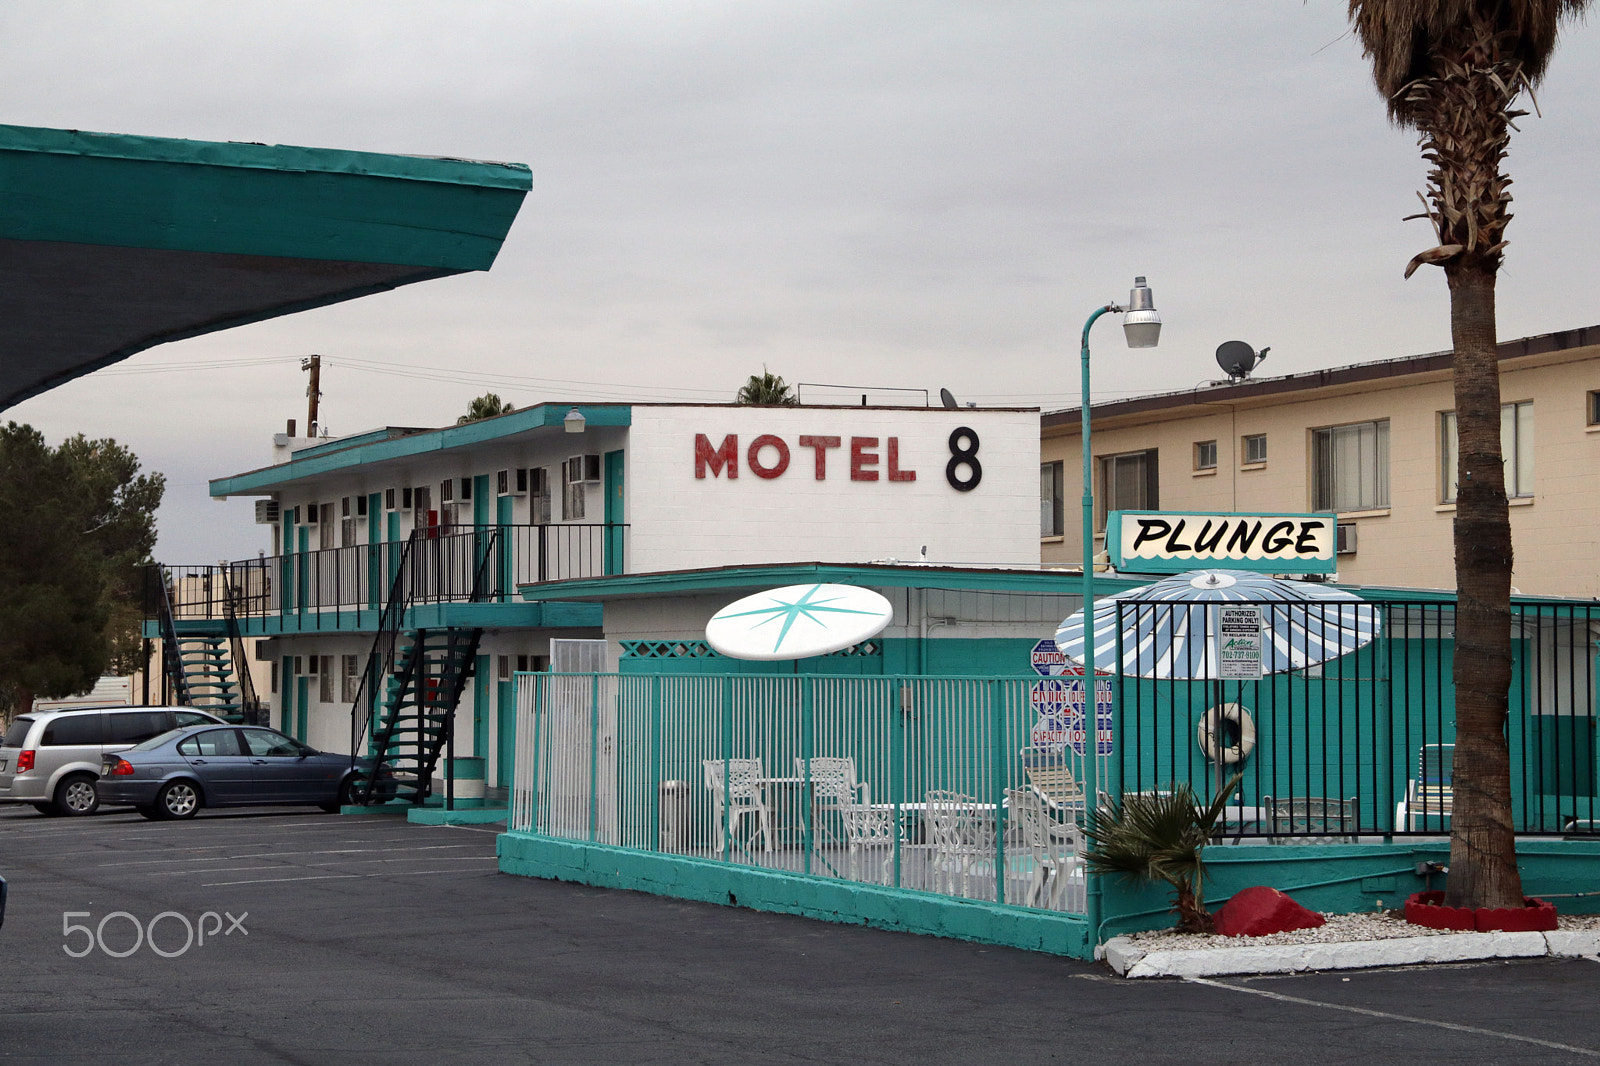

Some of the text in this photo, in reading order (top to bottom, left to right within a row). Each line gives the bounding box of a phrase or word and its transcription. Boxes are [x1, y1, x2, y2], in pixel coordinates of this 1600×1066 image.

[695, 426, 983, 492] MOTEL 8
[1133, 518, 1325, 554] PLUNGE
[1225, 638, 1254, 649] Action
[1032, 652, 1066, 664] CAUTION
